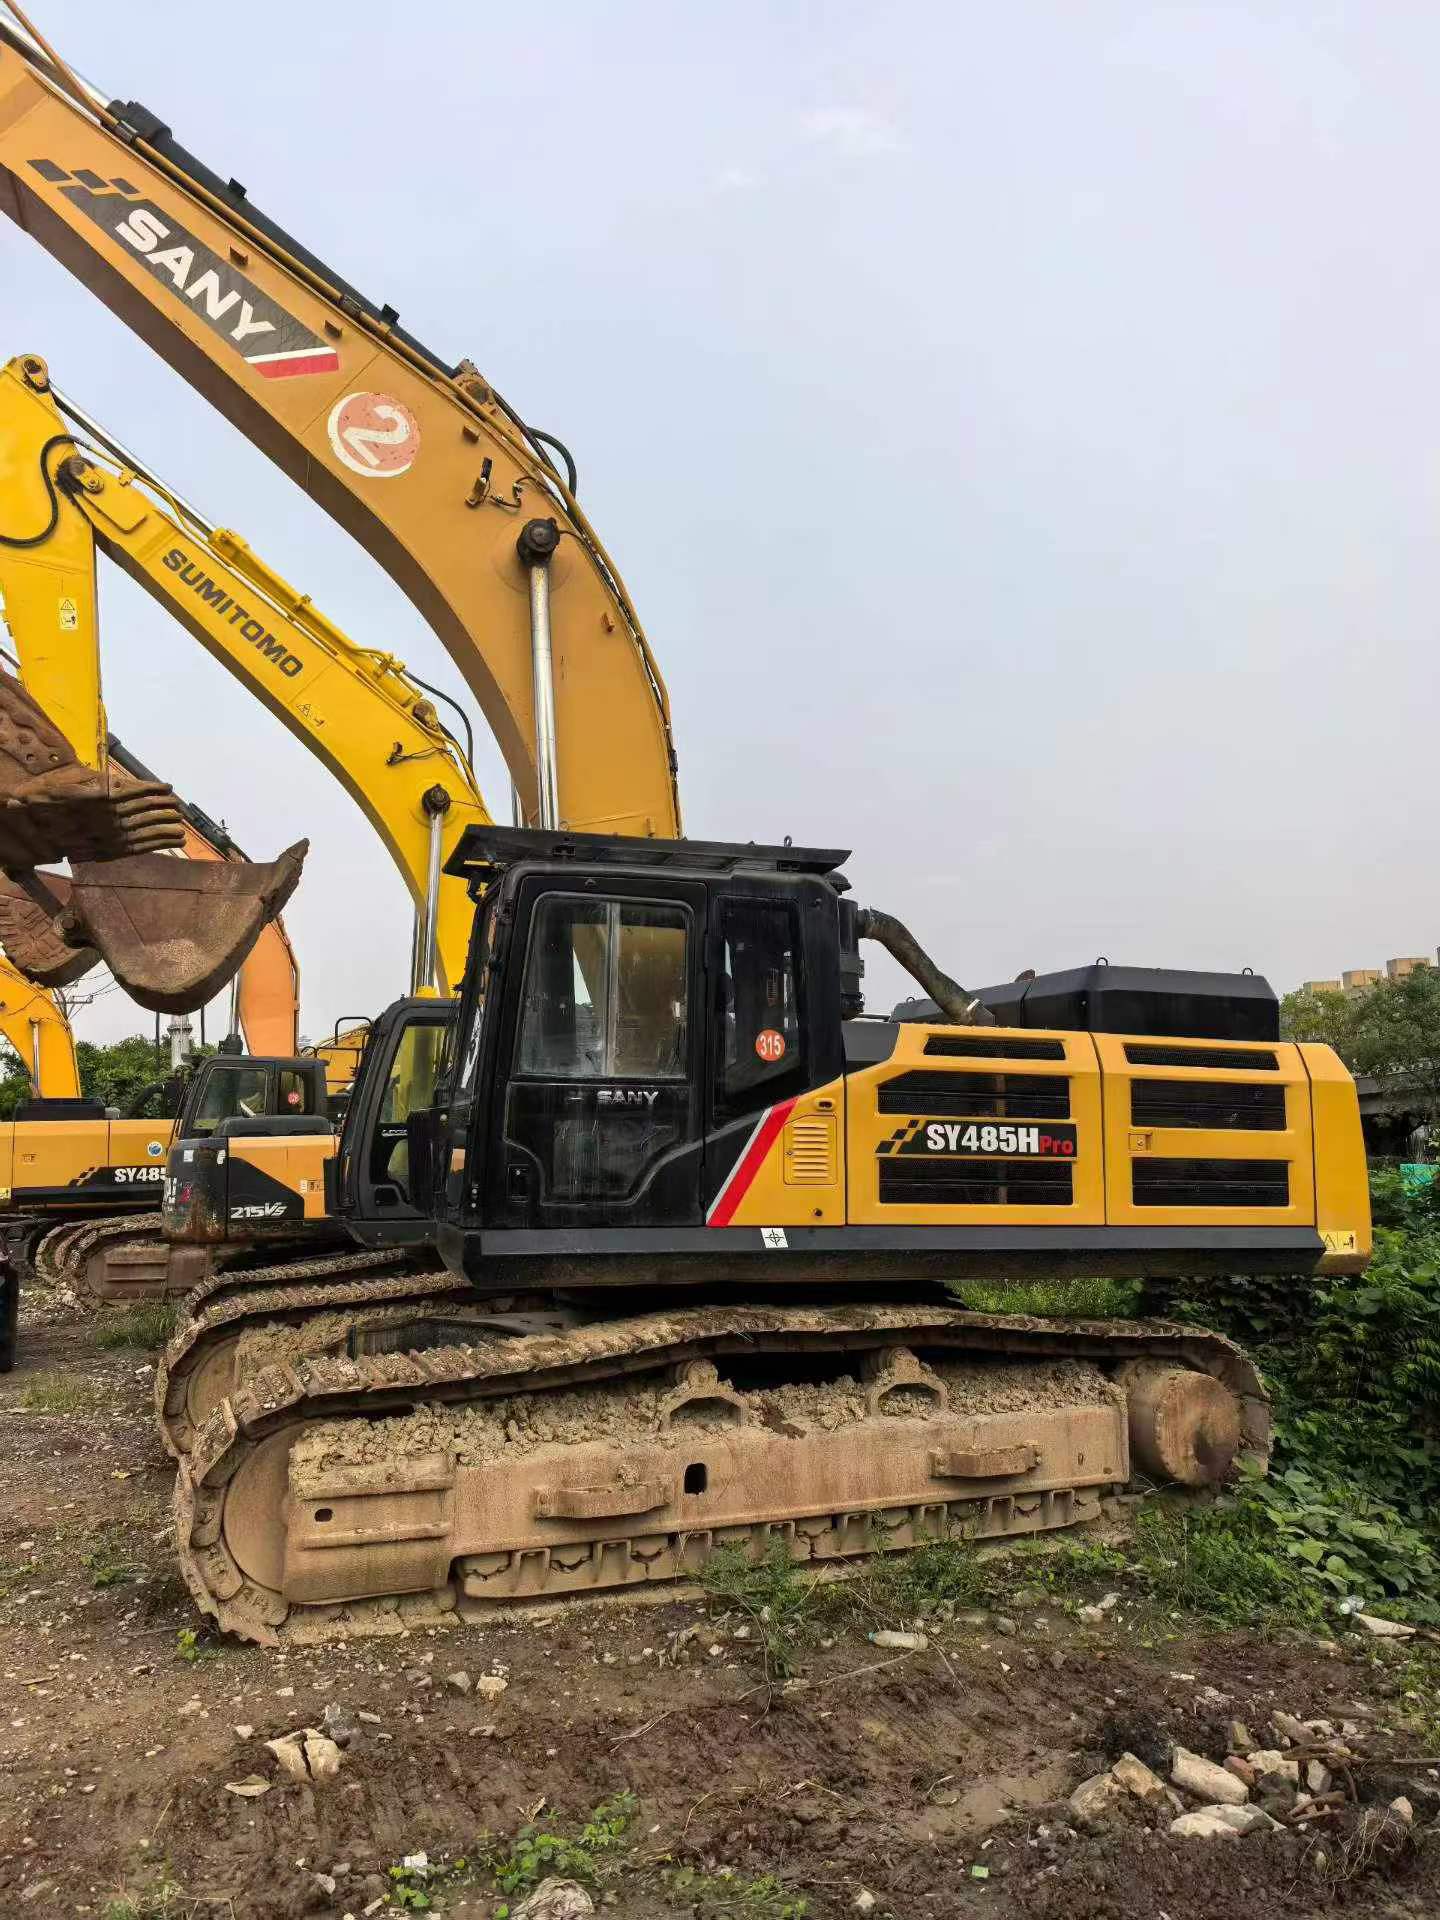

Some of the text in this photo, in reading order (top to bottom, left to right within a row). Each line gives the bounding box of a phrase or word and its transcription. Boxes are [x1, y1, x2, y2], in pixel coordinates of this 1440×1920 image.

[114, 208, 277, 342] SANY
[342, 405, 411, 466] 2
[161, 548, 304, 678] SUMITOMO
[760, 1034, 781, 1057] 315
[597, 1090, 659, 1104] SANY
[926, 1123, 1074, 1155] SY485H Pro
